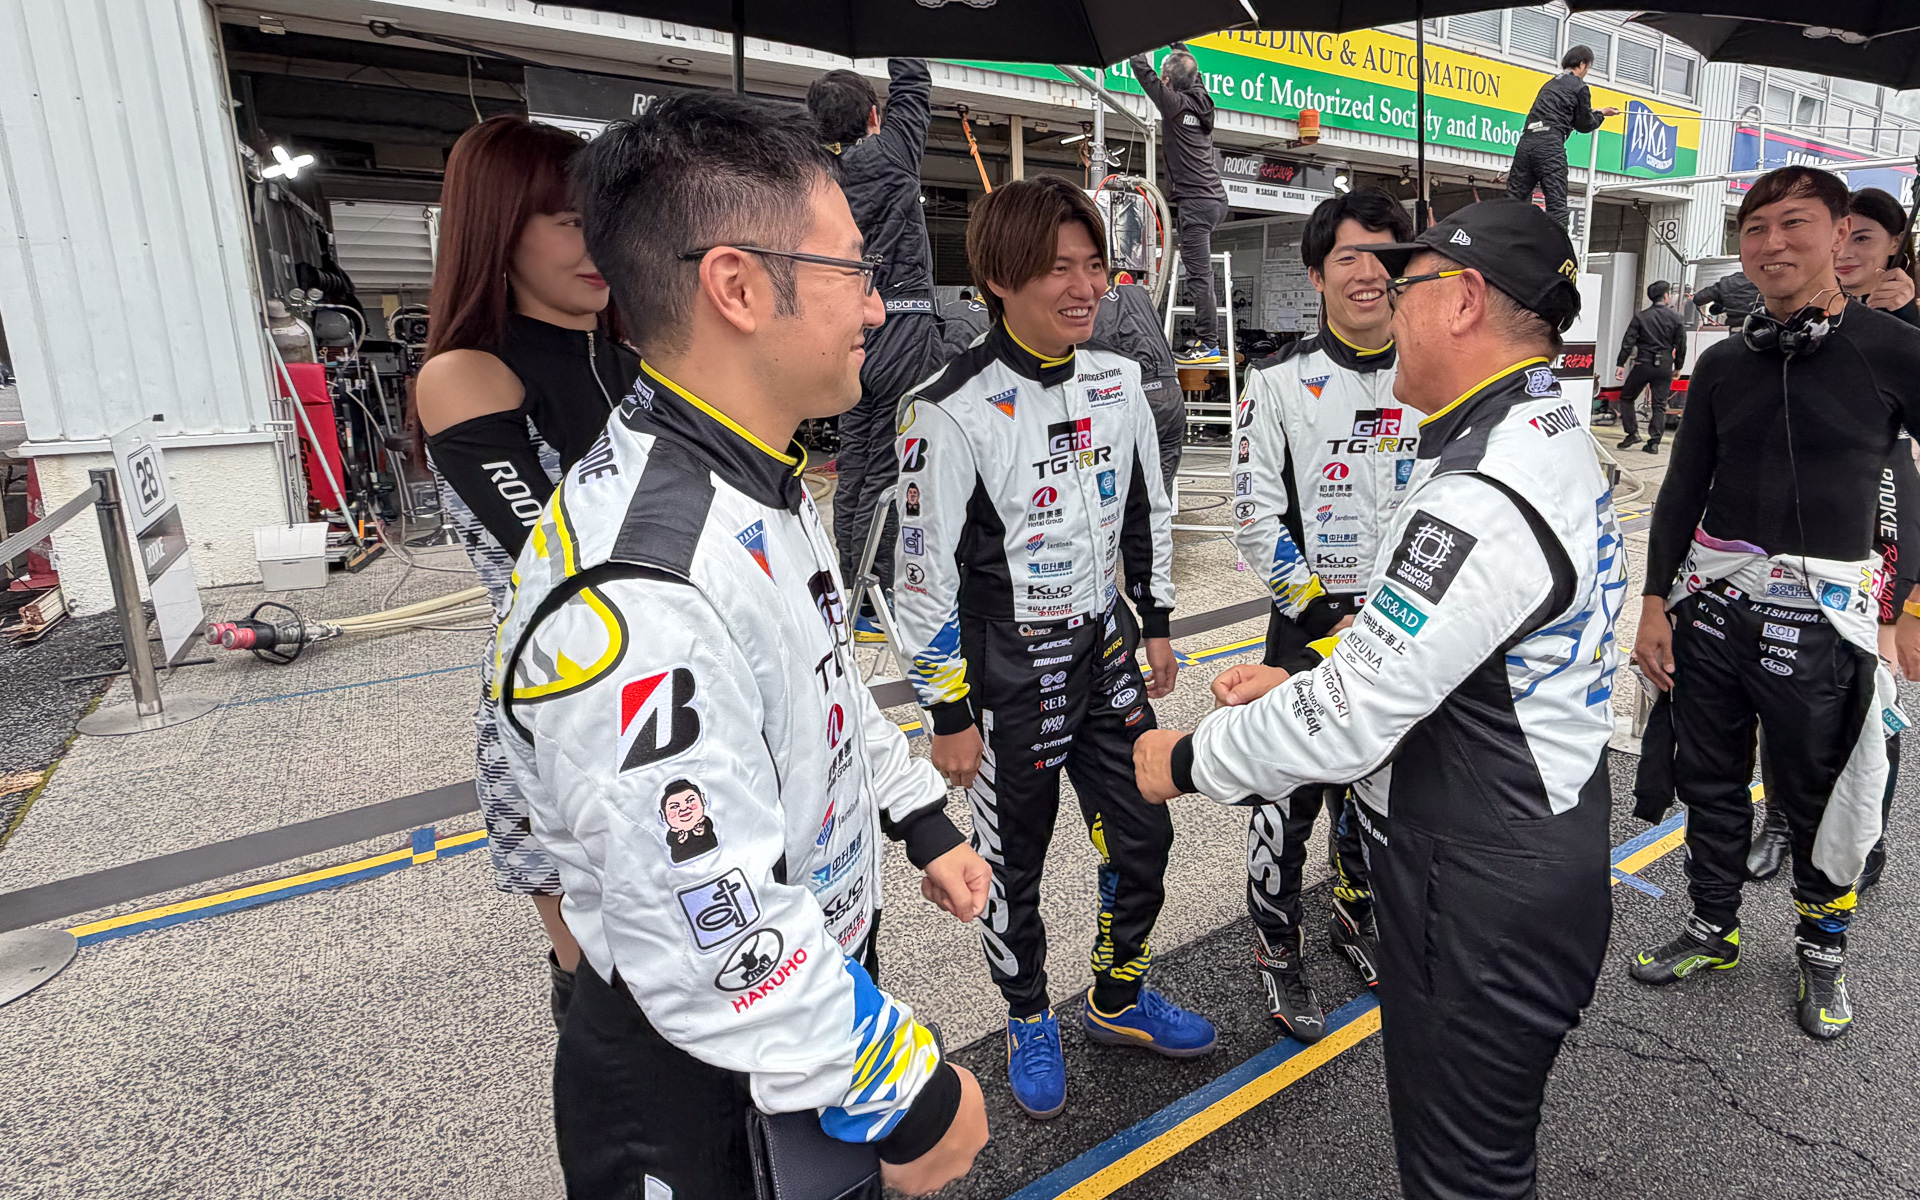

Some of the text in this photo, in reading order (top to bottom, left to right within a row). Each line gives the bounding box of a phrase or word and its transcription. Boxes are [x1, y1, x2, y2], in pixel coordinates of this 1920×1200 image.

[1340, 39, 1357, 67] &
[1362, 45, 1501, 98] AUTOMATION
[1241, 73, 1265, 101] of
[1270, 76, 1374, 121] Motorized
[1380, 98, 1443, 140] Socity
[1447, 115, 1477, 140] and
[1480, 117, 1524, 146] Robo
[1631, 106, 1667, 164] ASKA
[1224, 157, 1258, 175] ROOKIE
[1659, 222, 1677, 241] 18
[886, 300, 931, 311] sparco
[1078, 367, 1122, 382] BRIDGESTONE
[136, 457, 159, 504] 28
[1879, 468, 1898, 540] ROOKIE
[1045, 518, 1064, 527] Group
[1047, 541, 1073, 550] Jardines
[1397, 568, 1431, 592] WOVEN CITY
[1401, 561, 1434, 586] TOYOTA
[1027, 591, 1073, 600] GROUP
[1047, 602, 1073, 611] STATES
[1046, 607, 1073, 617] TOYOTA
[1376, 590, 1419, 628] MS&AD
[1750, 604, 1819, 623] H.ISHIURA
[1347, 631, 1383, 669] KIZUNA
[1768, 645, 1798, 659] FOX
[1766, 660, 1789, 674] Arai
[1113, 673, 1131, 693] KINTO
[1321, 662, 1350, 718] HITOTOKI
[824, 889, 864, 929] ROUP
[839, 918, 866, 948] OYOTA
[731, 948, 808, 1014] HAKUHO
